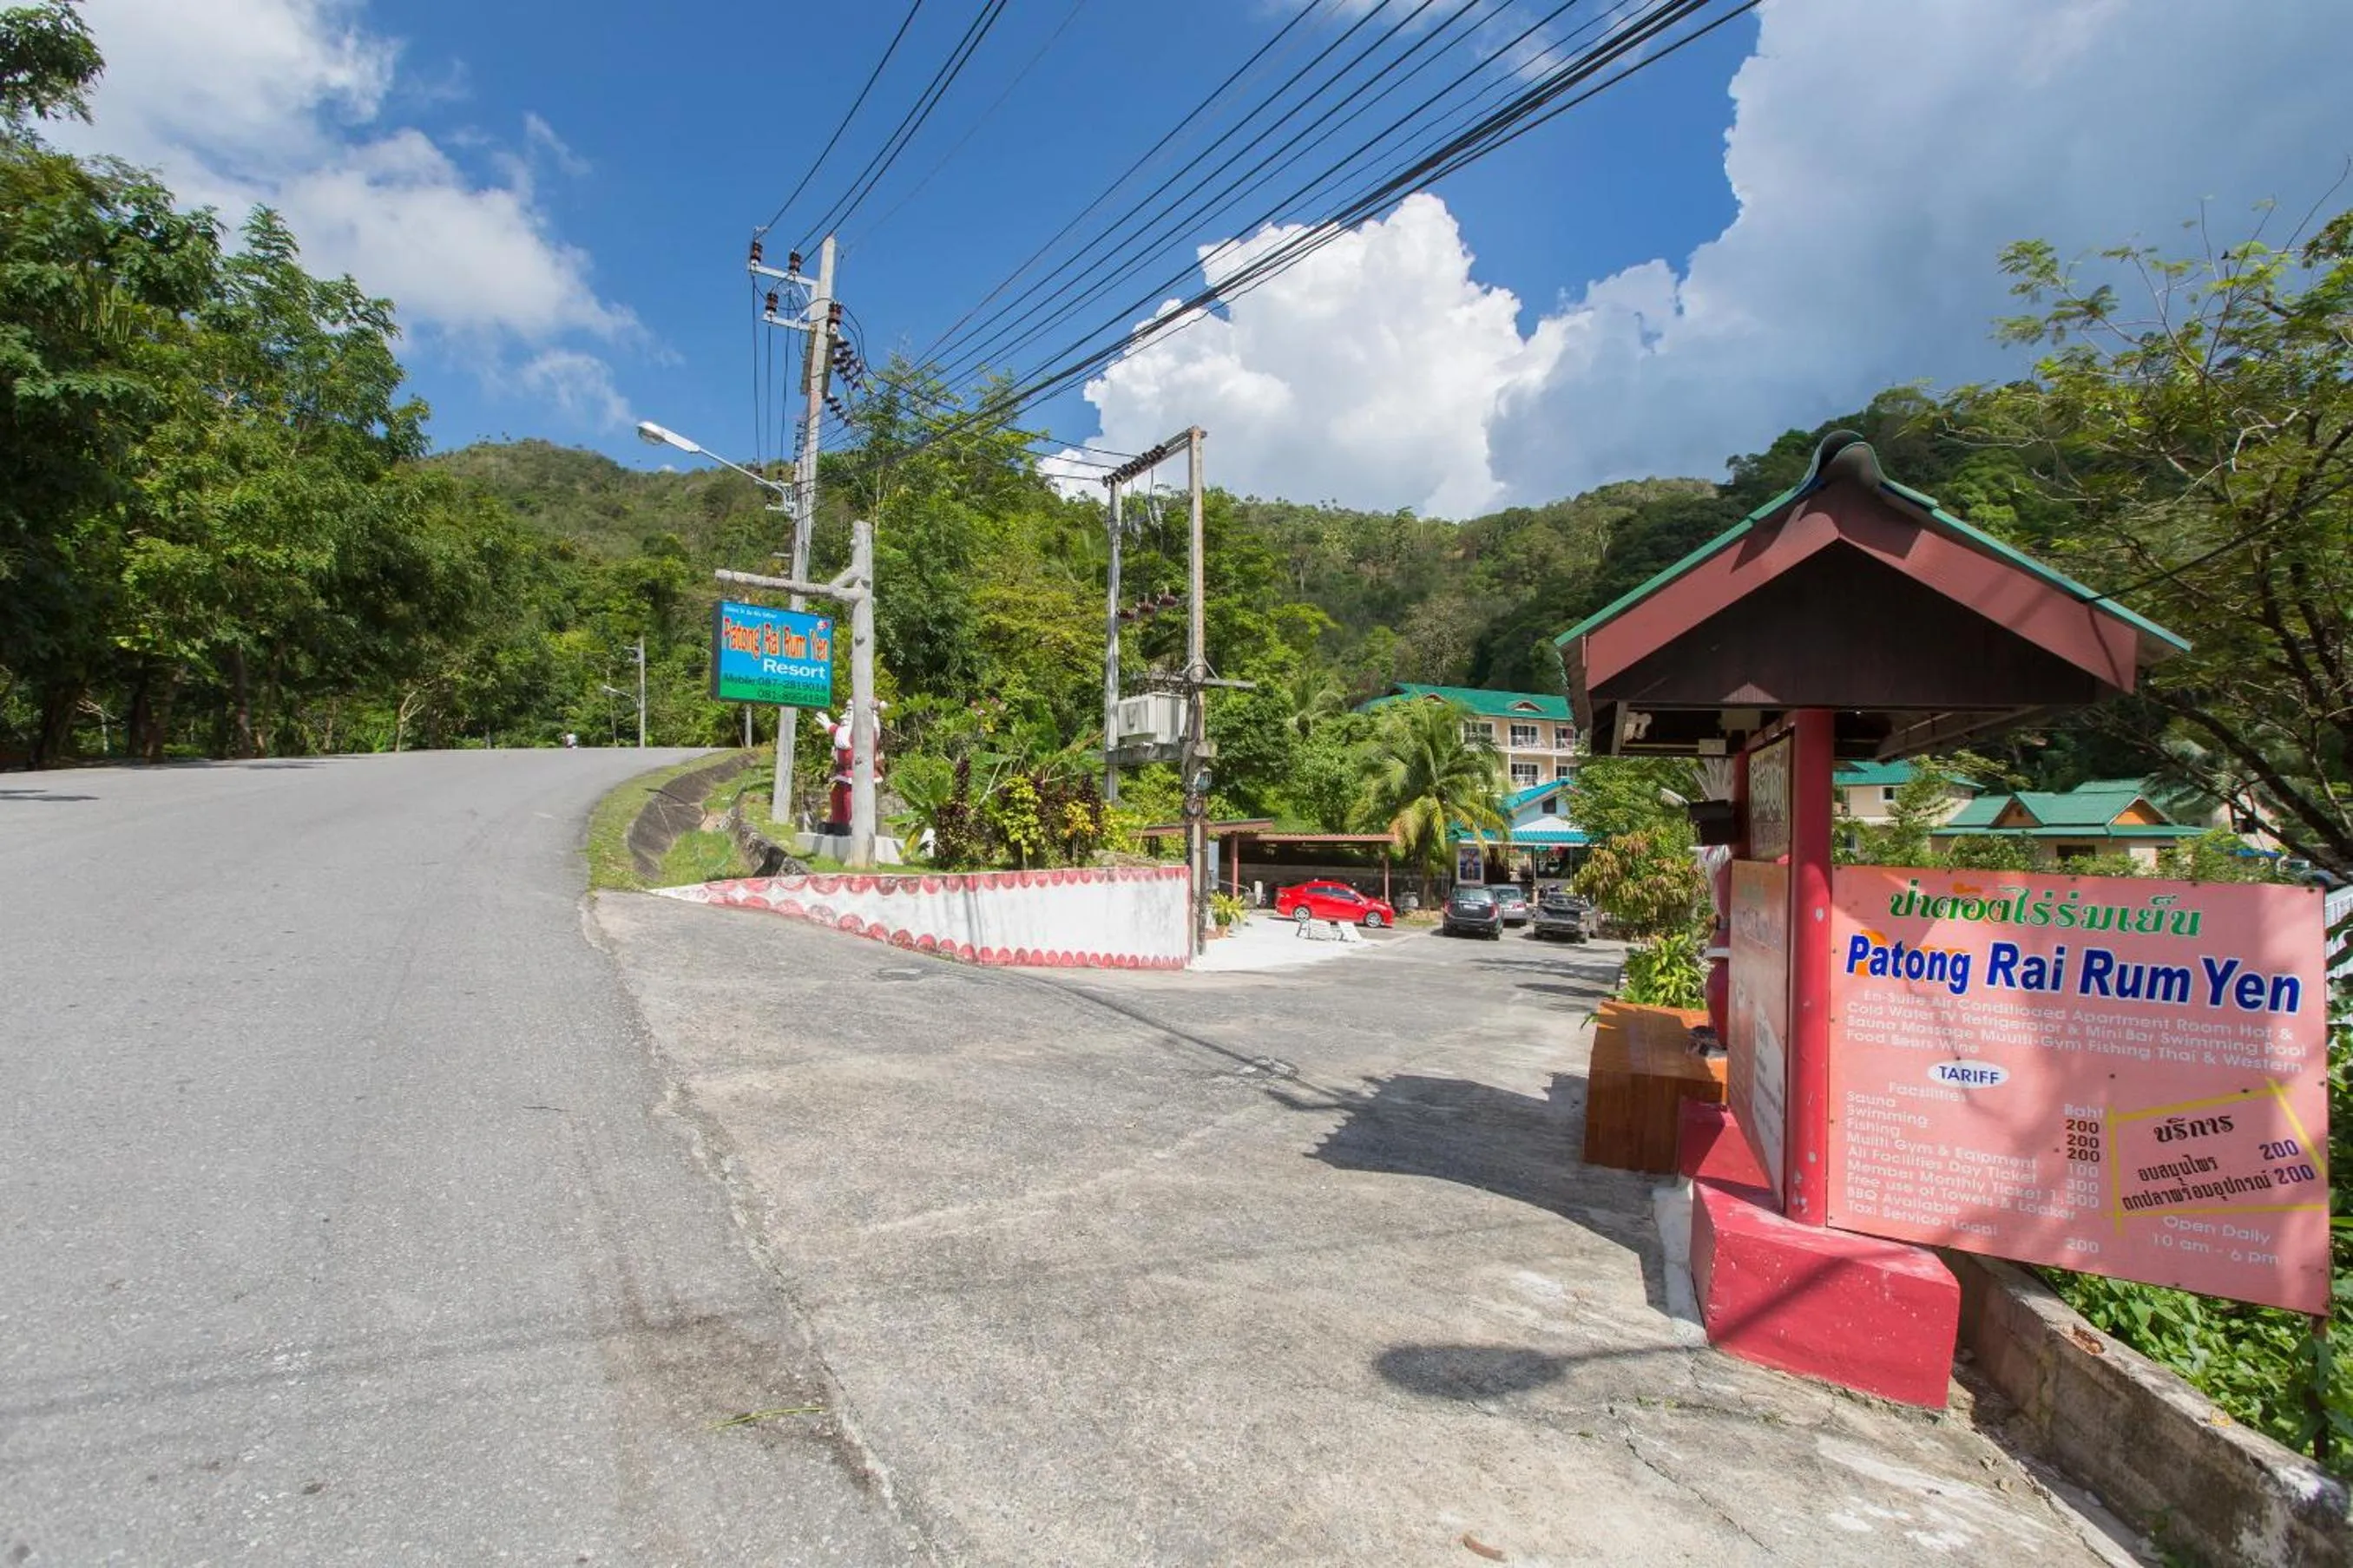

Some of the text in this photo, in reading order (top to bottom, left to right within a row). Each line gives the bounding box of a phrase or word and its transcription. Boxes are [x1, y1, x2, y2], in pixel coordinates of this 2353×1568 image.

[763, 658, 825, 679] Resort
[1845, 934, 2302, 1015] Patong Rai Rum Yen
[1847, 1001, 1883, 1015] Cold
[1889, 1005, 1935, 1020] Water
[1941, 1010, 1957, 1021] TV
[2067, 1025, 2080, 1035] &
[2161, 1033, 2258, 1056] Swimming
[2265, 1042, 2306, 1057] Pool
[1847, 1028, 1885, 1044] Food
[1932, 997, 1952, 1008] Air
[2072, 1009, 2169, 1031] Apartment
[2177, 1019, 2231, 1035] Room
[2239, 1023, 2272, 1040] Hot
[2279, 1027, 2293, 1040] &
[1847, 1016, 1896, 1030] Sauna
[1902, 1021, 1974, 1040] Massage
[2088, 1041, 2151, 1061] Fishing
[2159, 1047, 2197, 1062] Thai
[2204, 1052, 2216, 1064] &
[2223, 1054, 2302, 1073] Western
[1938, 1066, 2000, 1085] TARIFF
[1847, 1091, 2100, 1134] Sauna 200
[1847, 1105, 2100, 1149] Swimming 200
[2064, 1103, 2103, 1119] Baht
[2153, 1116, 2235, 1143] บริการ
[1847, 1118, 2100, 1163] Fishing 200
[1895, 1139, 1933, 1155] Gym
[1938, 1145, 1948, 1157] &
[2069, 1164, 2099, 1178] 100
[2258, 1139, 2299, 1161] 200
[1847, 1159, 1913, 1180] Member
[1920, 1171, 1985, 1192] Monthly
[1992, 1182, 2041, 1200] Ticket
[1848, 1145, 1866, 1158] All
[1872, 1150, 1942, 1170] Facilities
[1949, 1160, 1982, 1178] Day
[1988, 1165, 2036, 1183] Ticket
[2273, 1165, 2316, 1185] 200
[1847, 1172, 1880, 1188] Free
[1886, 1182, 1914, 1192] use
[1919, 1185, 1936, 1197] of
[1941, 1187, 1994, 1206] Towels
[2019, 1200, 2077, 1221] Locker
[1847, 1186, 1960, 1215] BBQ Available
[1847, 1200, 1876, 1216] Taxi
[2066, 1238, 2099, 1253] 200
[2162, 1215, 2271, 1244] Open Daily
[2179, 1239, 2210, 1253] am
[2231, 1249, 2243, 1262] 6
[2248, 1251, 2279, 1265] pm
